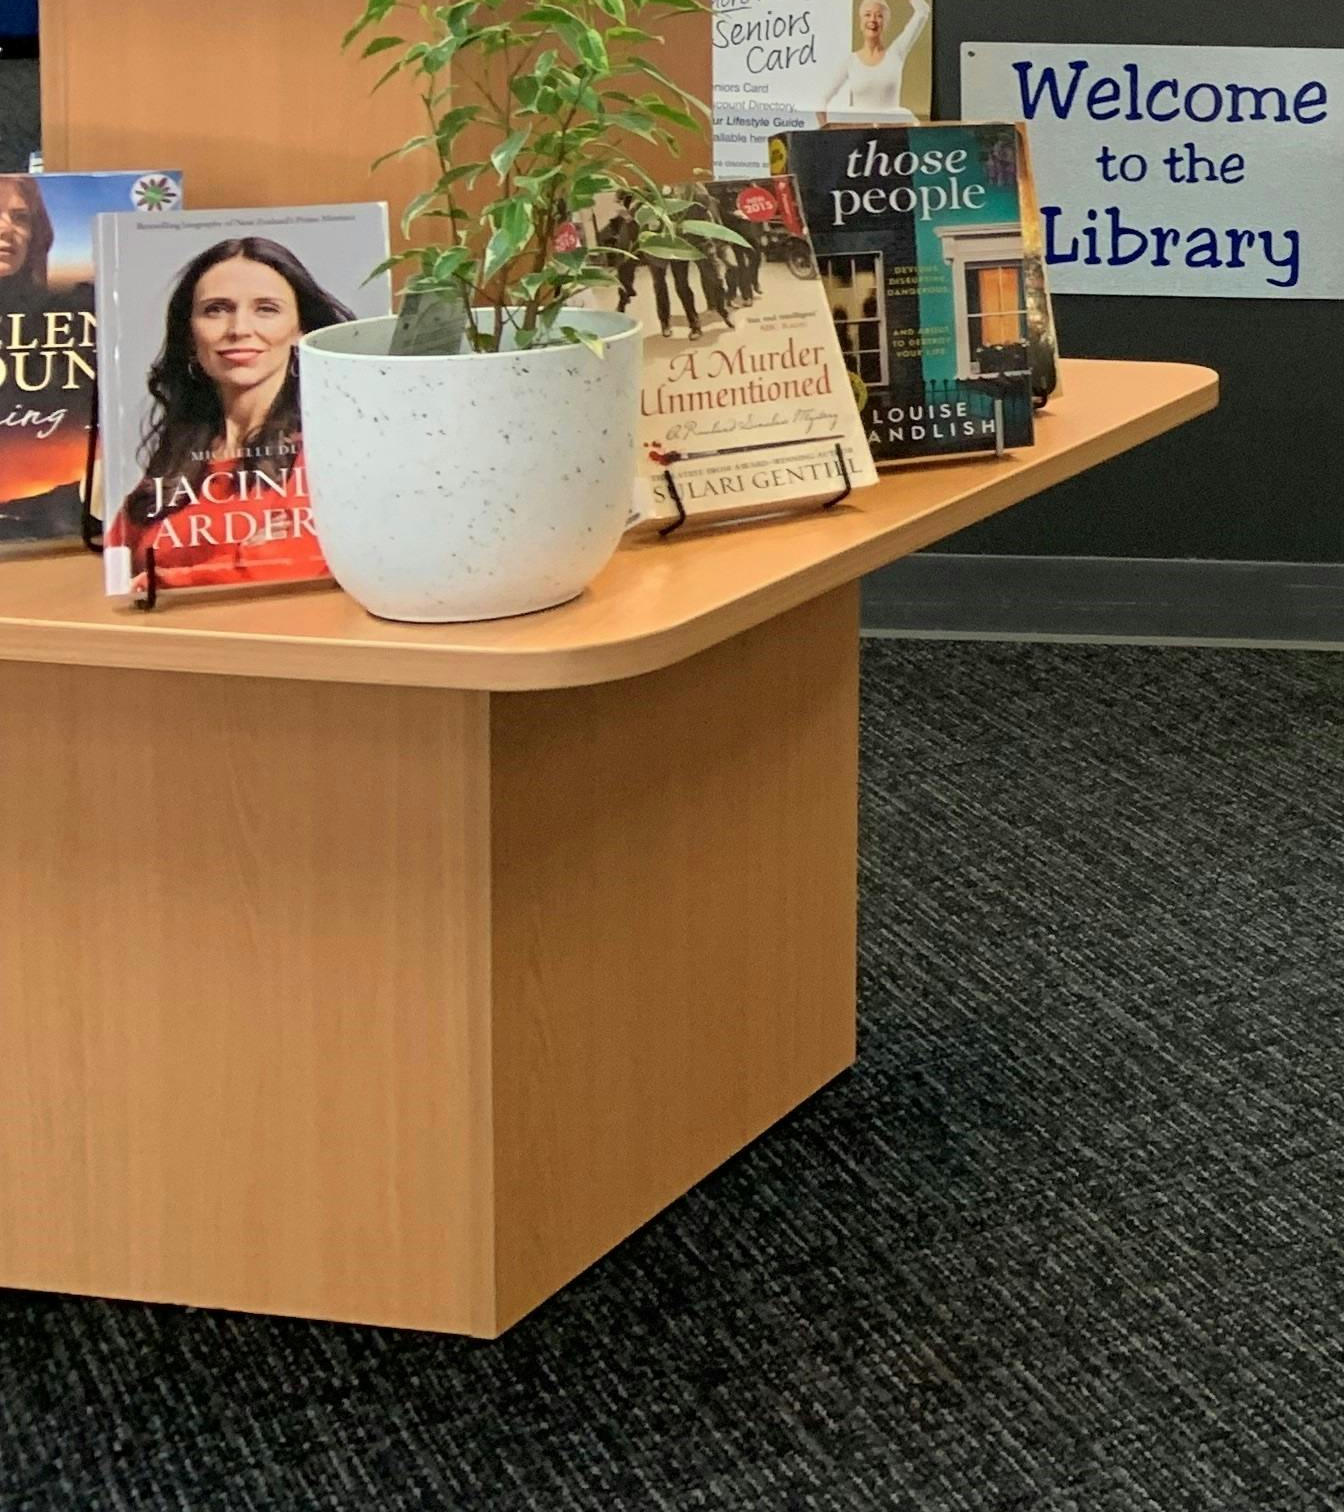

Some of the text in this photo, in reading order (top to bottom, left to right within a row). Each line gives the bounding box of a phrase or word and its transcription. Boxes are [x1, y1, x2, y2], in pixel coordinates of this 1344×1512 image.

[712, 9, 812, 49] Seniors
[746, 34, 818, 74] Card
[743, 82, 769, 94] Card
[1011, 59, 1328, 125] Welcome
[726, 116, 805, 129] Lifestyle Guide
[845, 140, 969, 178] those
[1095, 142, 1246, 184] to the
[830, 177, 986, 226] people
[1040, 205, 1301, 288] Library
[892, 339, 905, 348] TO
[893, 328, 915, 337] AND
[667, 340, 826, 384] A Murder
[639, 363, 833, 417] Unmentioned
[0, 404, 68, 439] ing
[868, 419, 996, 445] ANDLISH
[872, 402, 968, 425] LOUISE
[191, 445, 271, 461] MICHELLE
[152, 506, 319, 550] ARDER
